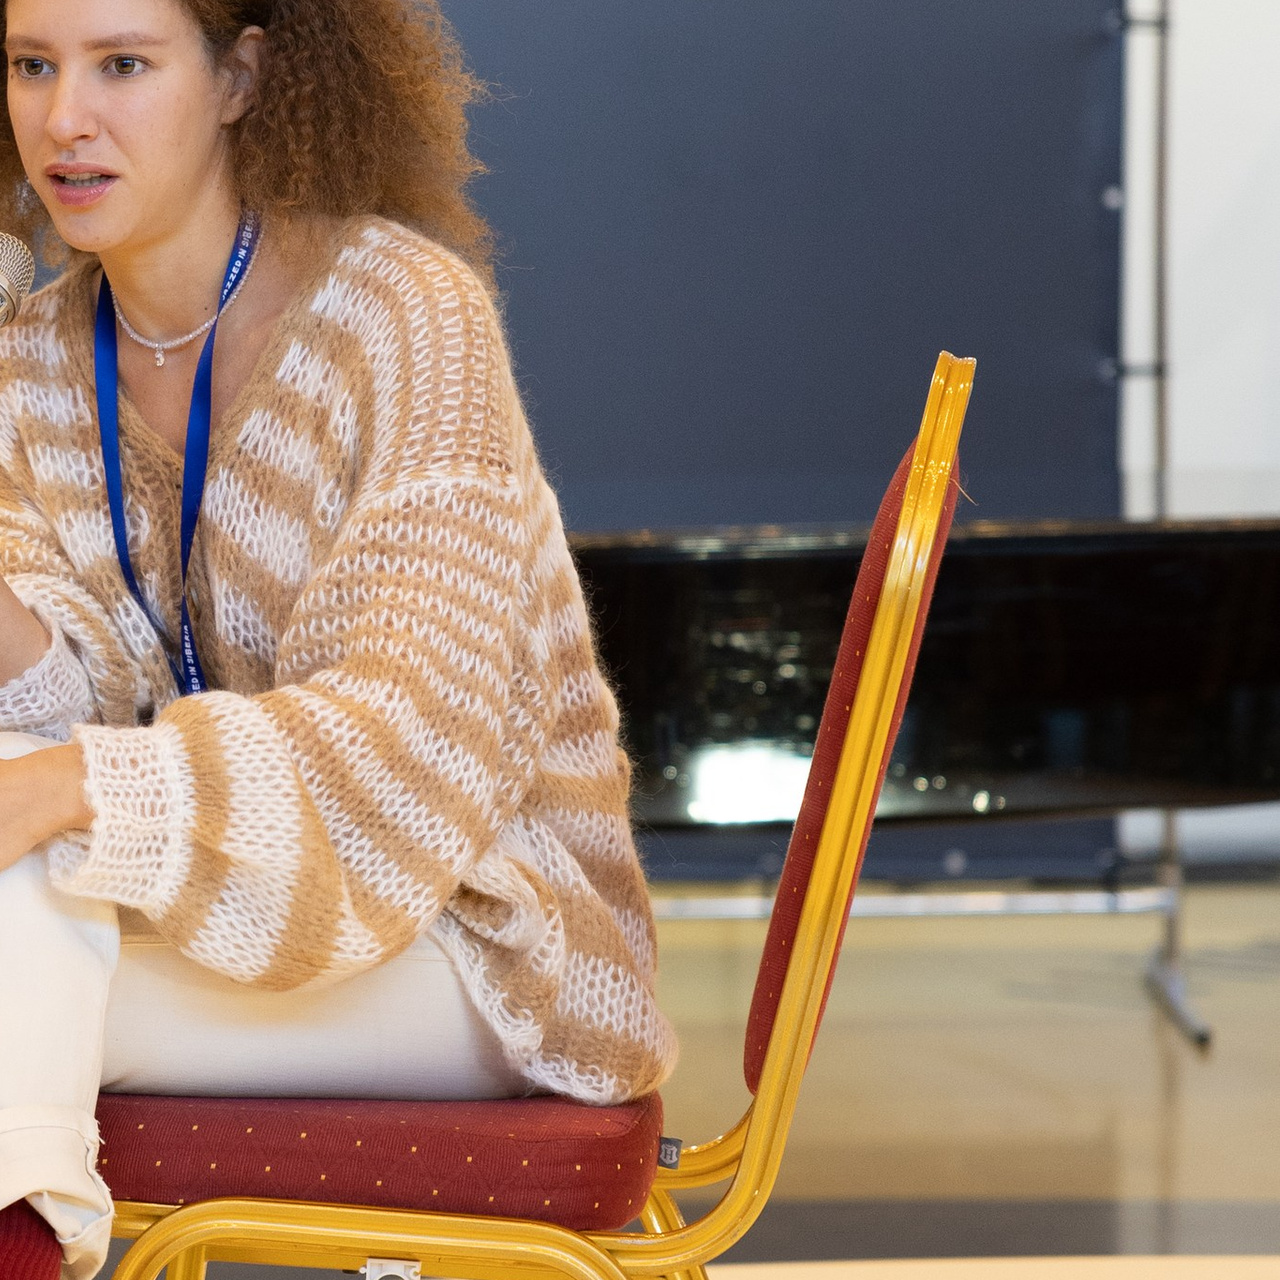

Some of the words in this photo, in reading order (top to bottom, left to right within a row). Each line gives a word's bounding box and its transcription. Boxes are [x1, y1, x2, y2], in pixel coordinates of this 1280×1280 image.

[222, 259, 242, 301] JAZZED
[238, 247, 248, 260] IN
[184, 625, 194, 664] SIBERIA
[188, 666, 197, 675] IN
